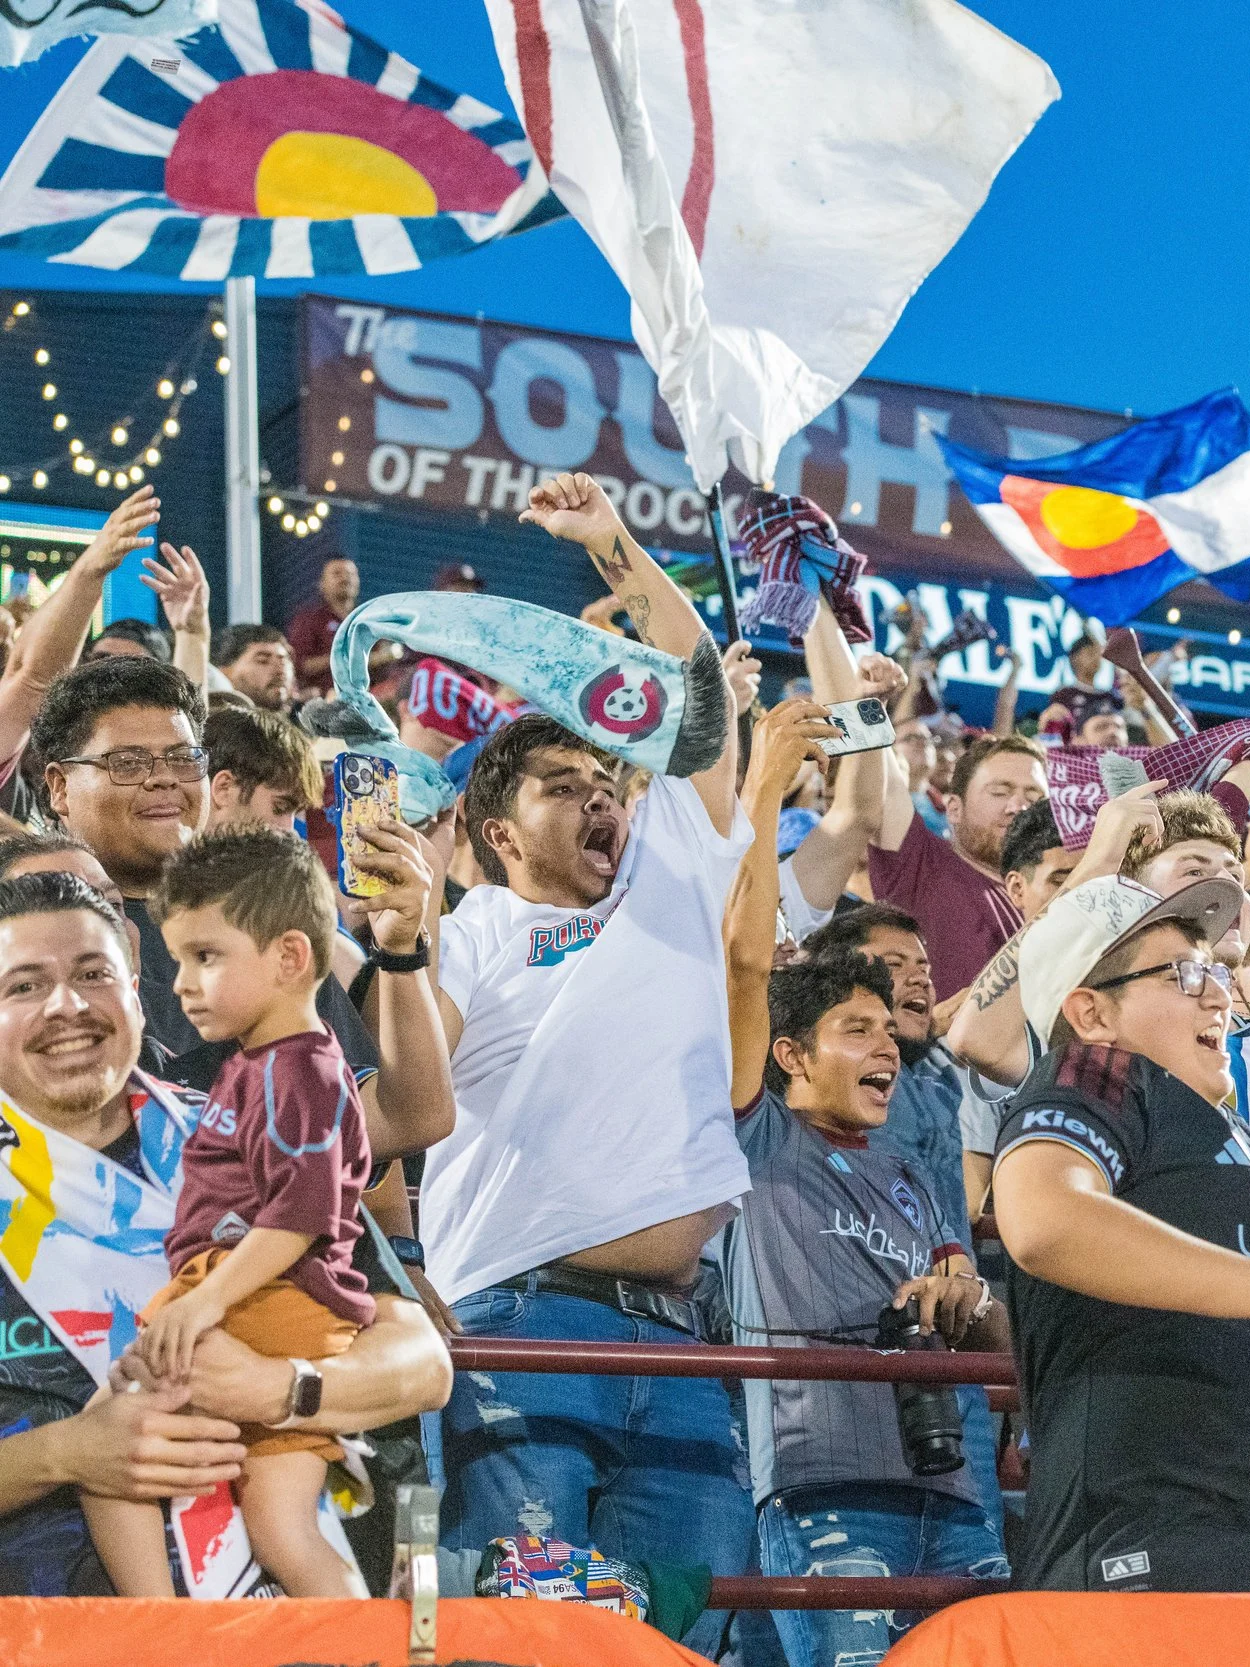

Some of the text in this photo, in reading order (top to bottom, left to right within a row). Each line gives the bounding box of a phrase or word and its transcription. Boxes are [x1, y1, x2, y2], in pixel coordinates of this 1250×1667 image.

[335, 304, 418, 358] The
[366, 443, 451, 499] OF
[462, 455, 566, 514] TH
